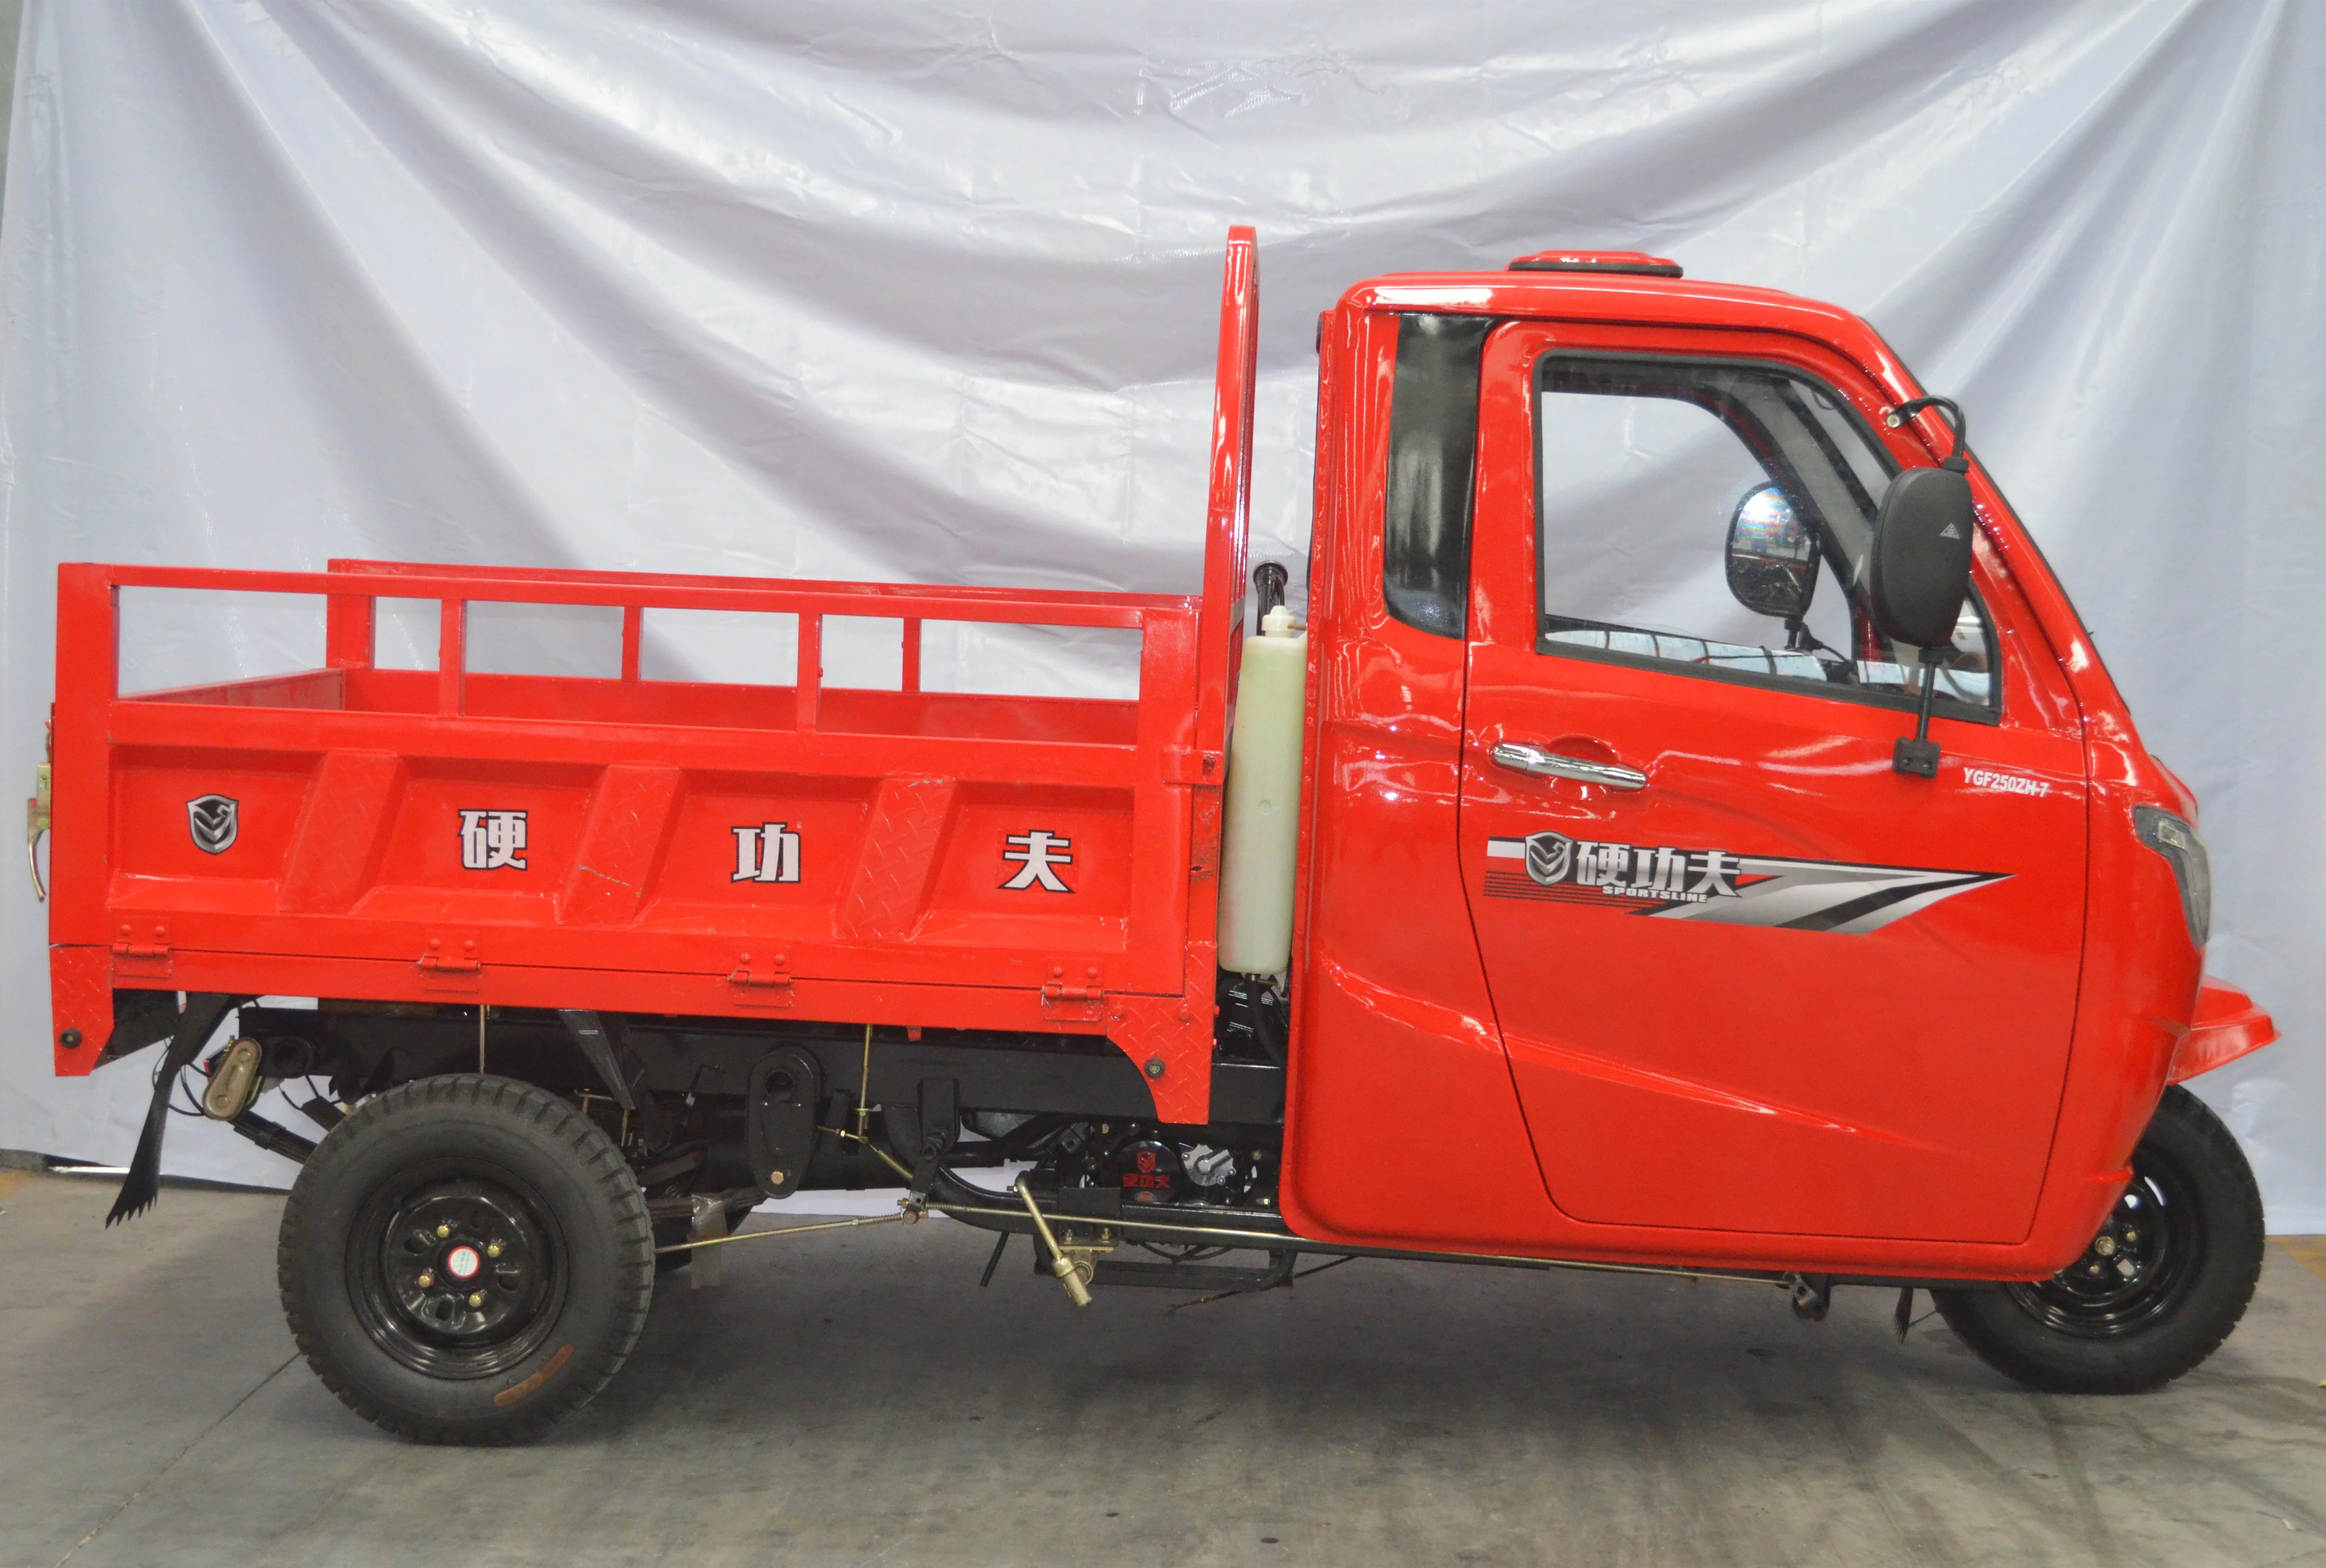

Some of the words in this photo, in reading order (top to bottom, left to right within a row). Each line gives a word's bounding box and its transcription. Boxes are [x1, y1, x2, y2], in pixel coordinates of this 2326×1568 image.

[1963, 767, 2049, 798] YGF250ZH-7
[458, 808, 528, 871] 硬
[731, 821, 801, 883] 功
[996, 830, 1075, 893] 夫
[1576, 840, 1741, 897] 硬功夫
[1602, 885, 1707, 903] SPORTSLINE
